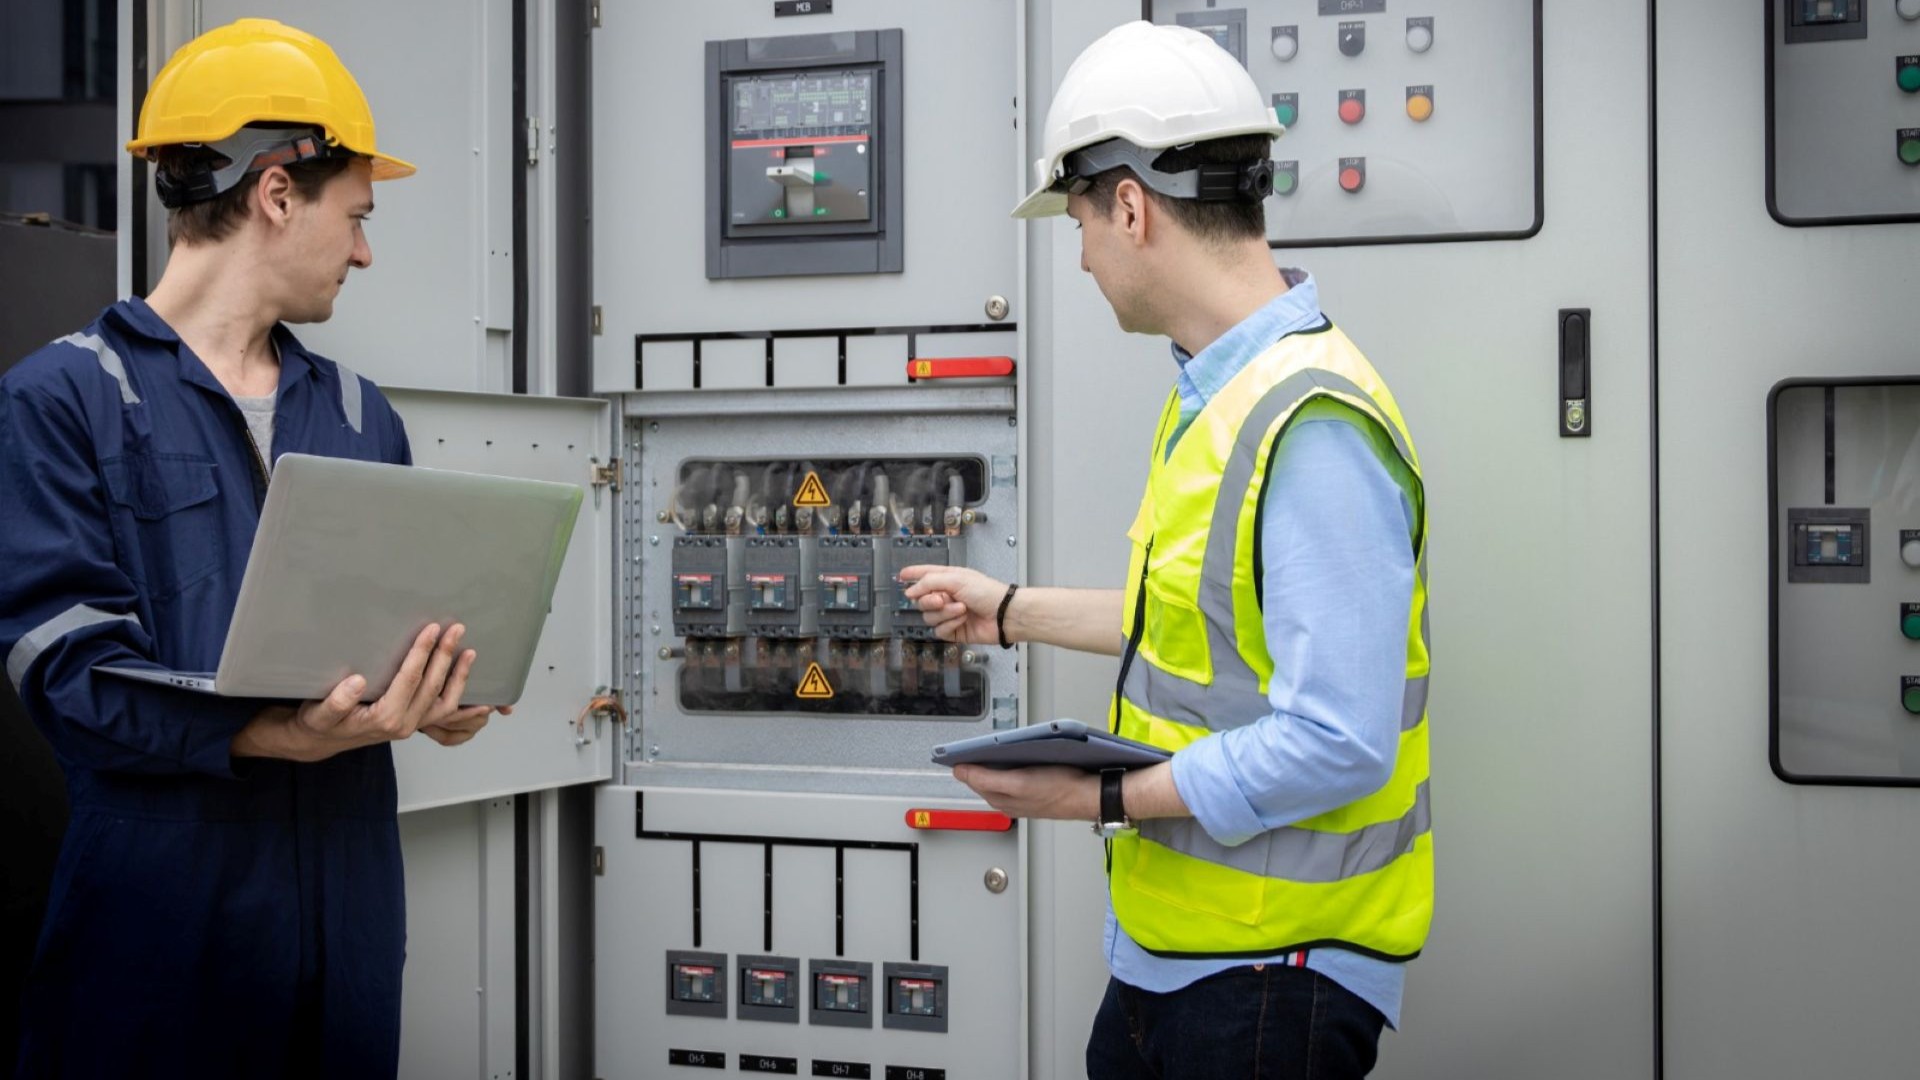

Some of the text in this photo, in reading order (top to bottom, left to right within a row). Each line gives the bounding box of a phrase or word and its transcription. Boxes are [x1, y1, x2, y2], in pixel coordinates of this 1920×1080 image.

[796, 2, 811, 12] MCB
[688, 1053, 705, 1064] CH-5
[759, 1058, 776, 1069] CH-6
[832, 1064, 849, 1075] CH-7
